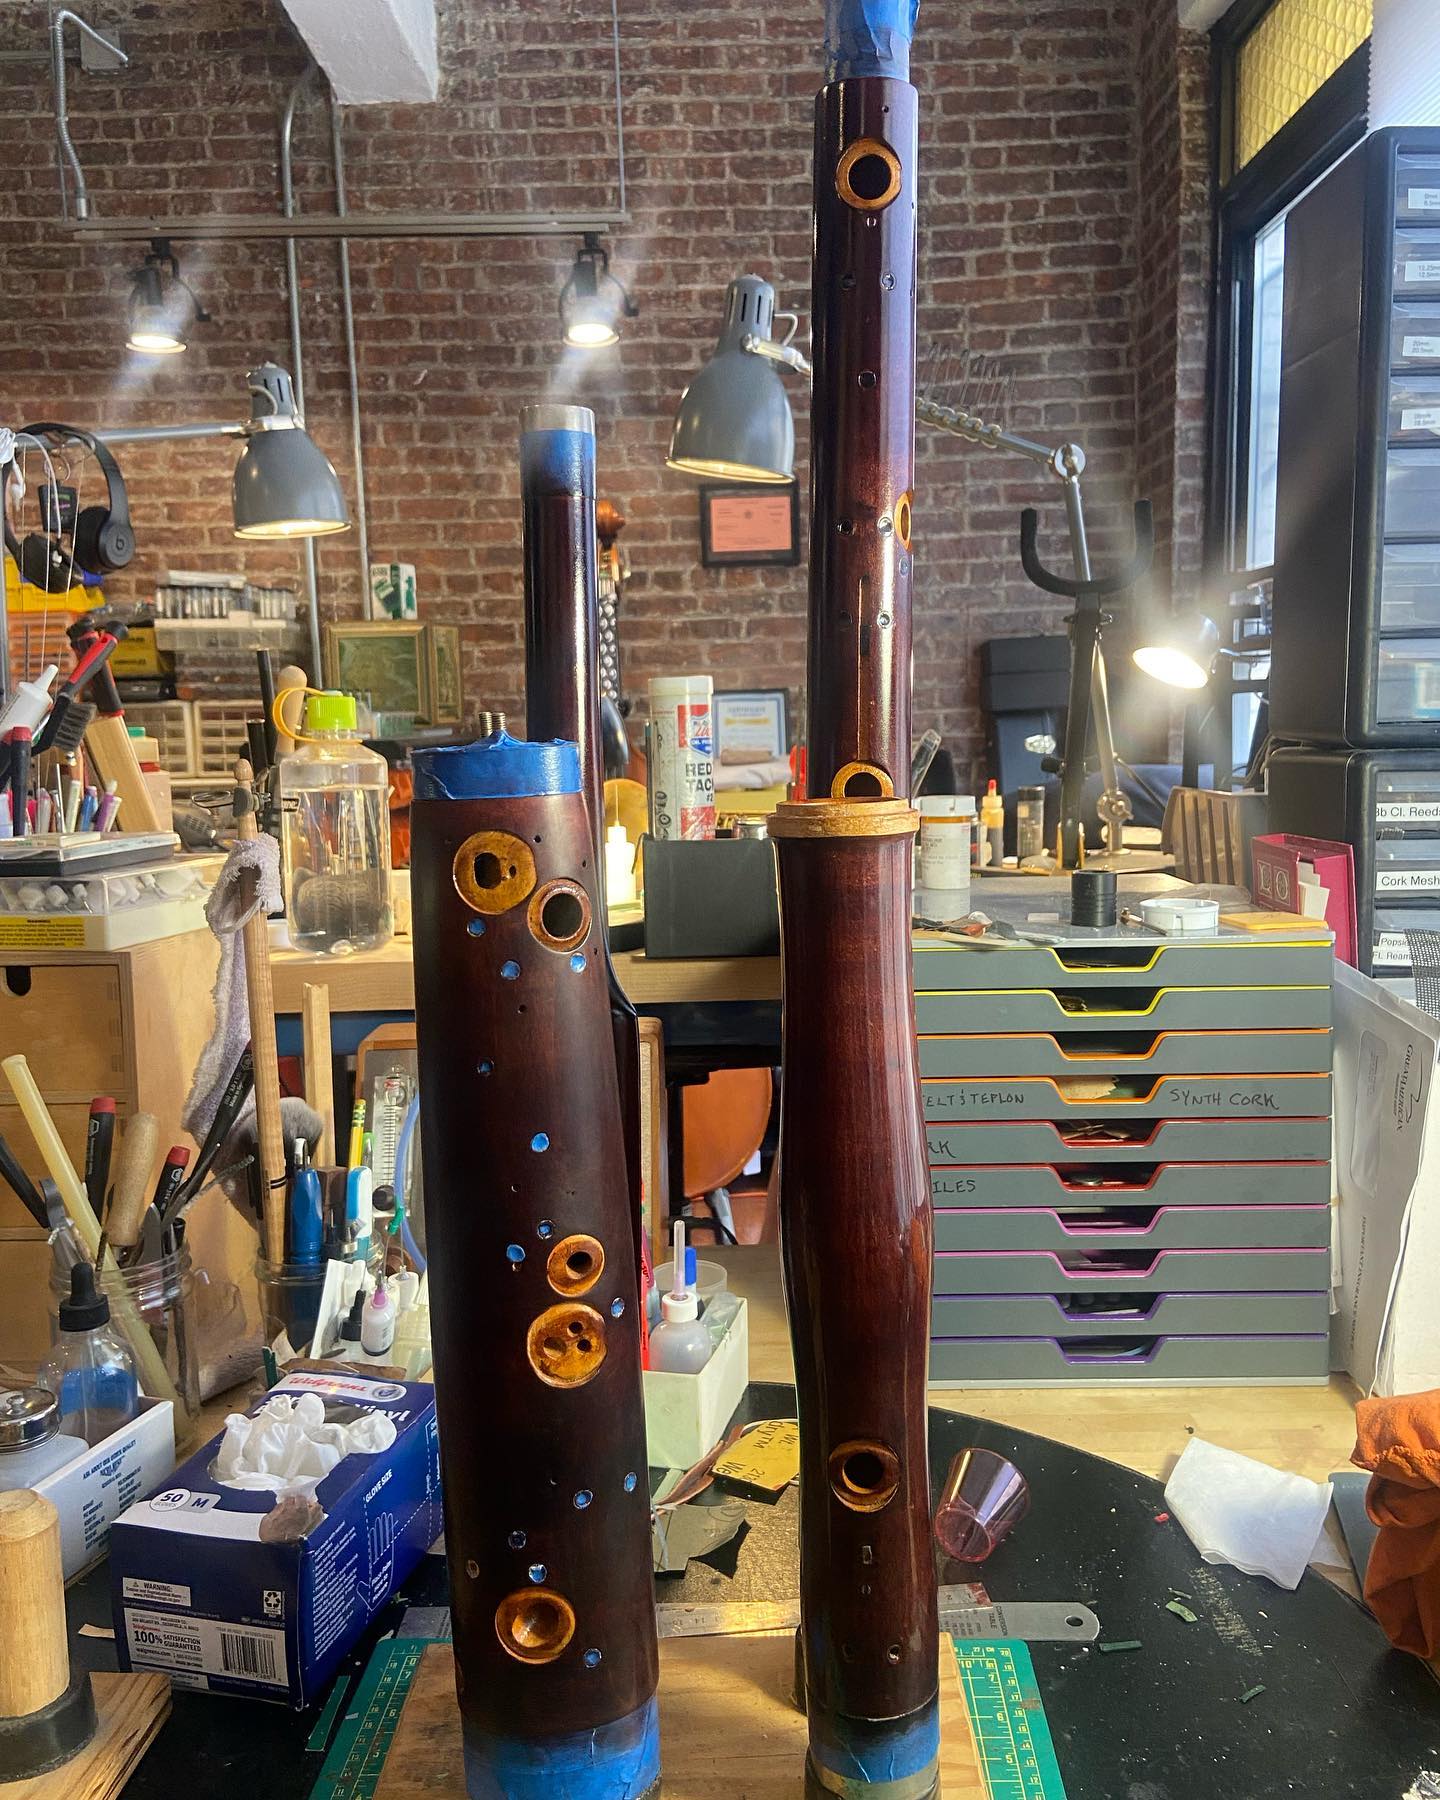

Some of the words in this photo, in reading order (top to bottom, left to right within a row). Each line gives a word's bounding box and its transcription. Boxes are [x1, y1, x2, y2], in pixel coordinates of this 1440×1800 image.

[685, 762, 713, 777] RED
[685, 778, 714, 792] TAC
[1381, 876, 1407, 887] Cork
[1410, 875, 1440, 886] Mesh
[1381, 937, 1408, 947] Pops
[1386, 951, 1411, 960] Ream
[922, 1093, 955, 1107] ELT
[1169, 1088, 1221, 1106] SYNTH
[1229, 1092, 1280, 1111] CORK
[927, 1141, 957, 1158] RK
[932, 1180, 976, 1194] ILES
[289, 1376, 367, 1392] Walgreens
[160, 1493, 184, 1503] 50
[191, 1497, 209, 1508] M
[134, 1630, 163, 1644] 100%
[163, 1634, 201, 1645] SATISFACTION
[163, 1641, 202, 1652] GUARANTEED
[1005, 1754, 1013, 1763] 5
